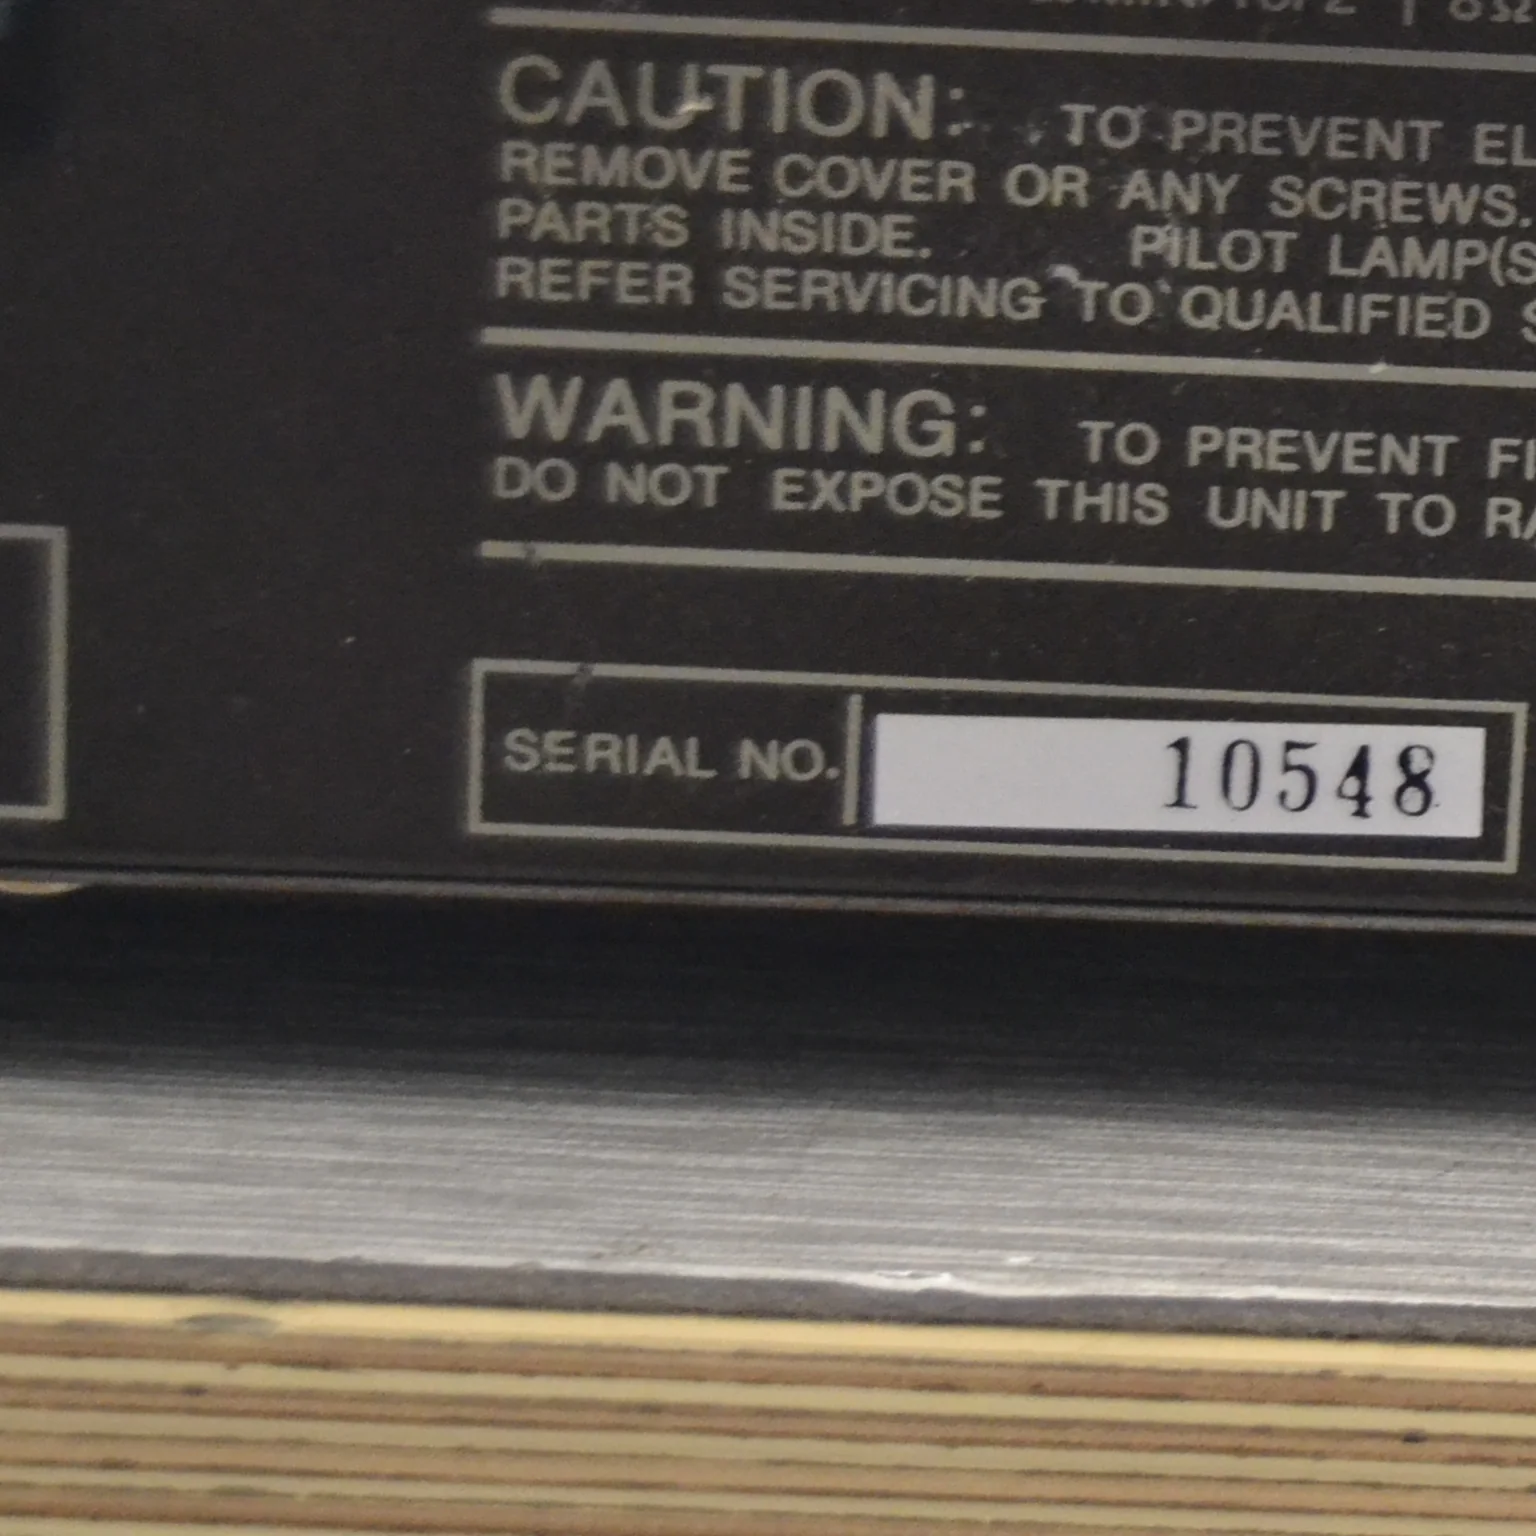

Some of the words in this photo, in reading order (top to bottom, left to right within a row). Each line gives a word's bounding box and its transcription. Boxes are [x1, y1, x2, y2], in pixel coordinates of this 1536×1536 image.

[497, 55, 967, 140] CAUTION:
[1061, 103, 1143, 149] TO
[1172, 108, 1441, 164] PREVENT
[500, 143, 751, 193] REMOVE
[774, 155, 974, 203] COVER
[1004, 164, 1088, 208] OR
[1118, 171, 1241, 213] ANY
[1268, 173, 1532, 229] SCREWS.
[497, 200, 689, 248] PARTS
[722, 209, 931, 259] INSIDE.
[1131, 226, 1297, 274] PILOT
[495, 260, 693, 306] REFER
[723, 268, 1045, 321] SERVICING
[1077, 281, 1153, 324] TO
[1180, 284, 1492, 340] QUALIFIED
[495, 373, 987, 457] WARNING:
[1078, 420, 1158, 466] TO
[1187, 425, 1458, 477] PREVENT
[492, 459, 576, 503] DO
[607, 465, 729, 509] NOT
[772, 469, 1002, 519] EXPOSE
[1036, 479, 1169, 525] THIS
[1207, 491, 1345, 534] UNIT
[1378, 493, 1455, 537] TO
[504, 729, 715, 780] SERIAL
[740, 741, 841, 783] NO.
[1163, 736, 1439, 818] 10548
